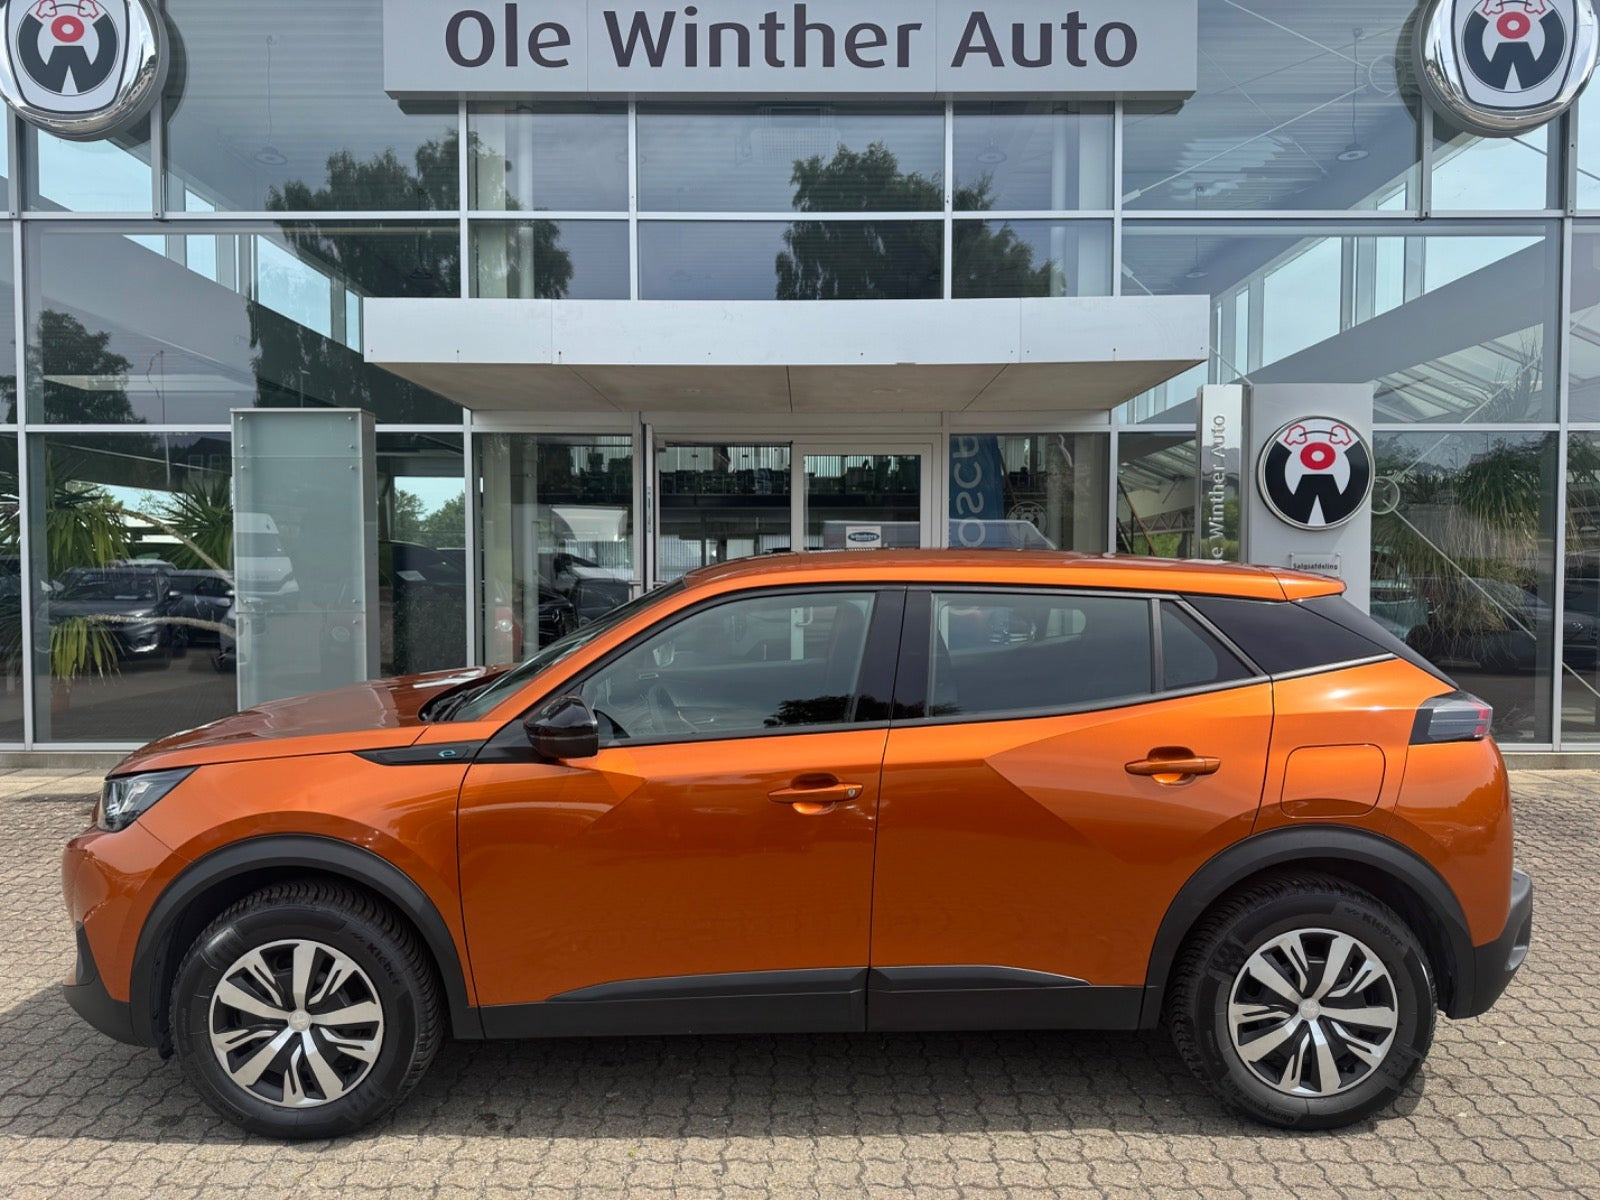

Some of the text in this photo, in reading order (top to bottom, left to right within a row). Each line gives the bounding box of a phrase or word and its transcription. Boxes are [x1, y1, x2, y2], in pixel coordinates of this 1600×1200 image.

[445, 2, 1138, 69] Ole Winther Auto
[1210, 415, 1226, 458] Auto
[1208, 463, 1225, 541] Winther
